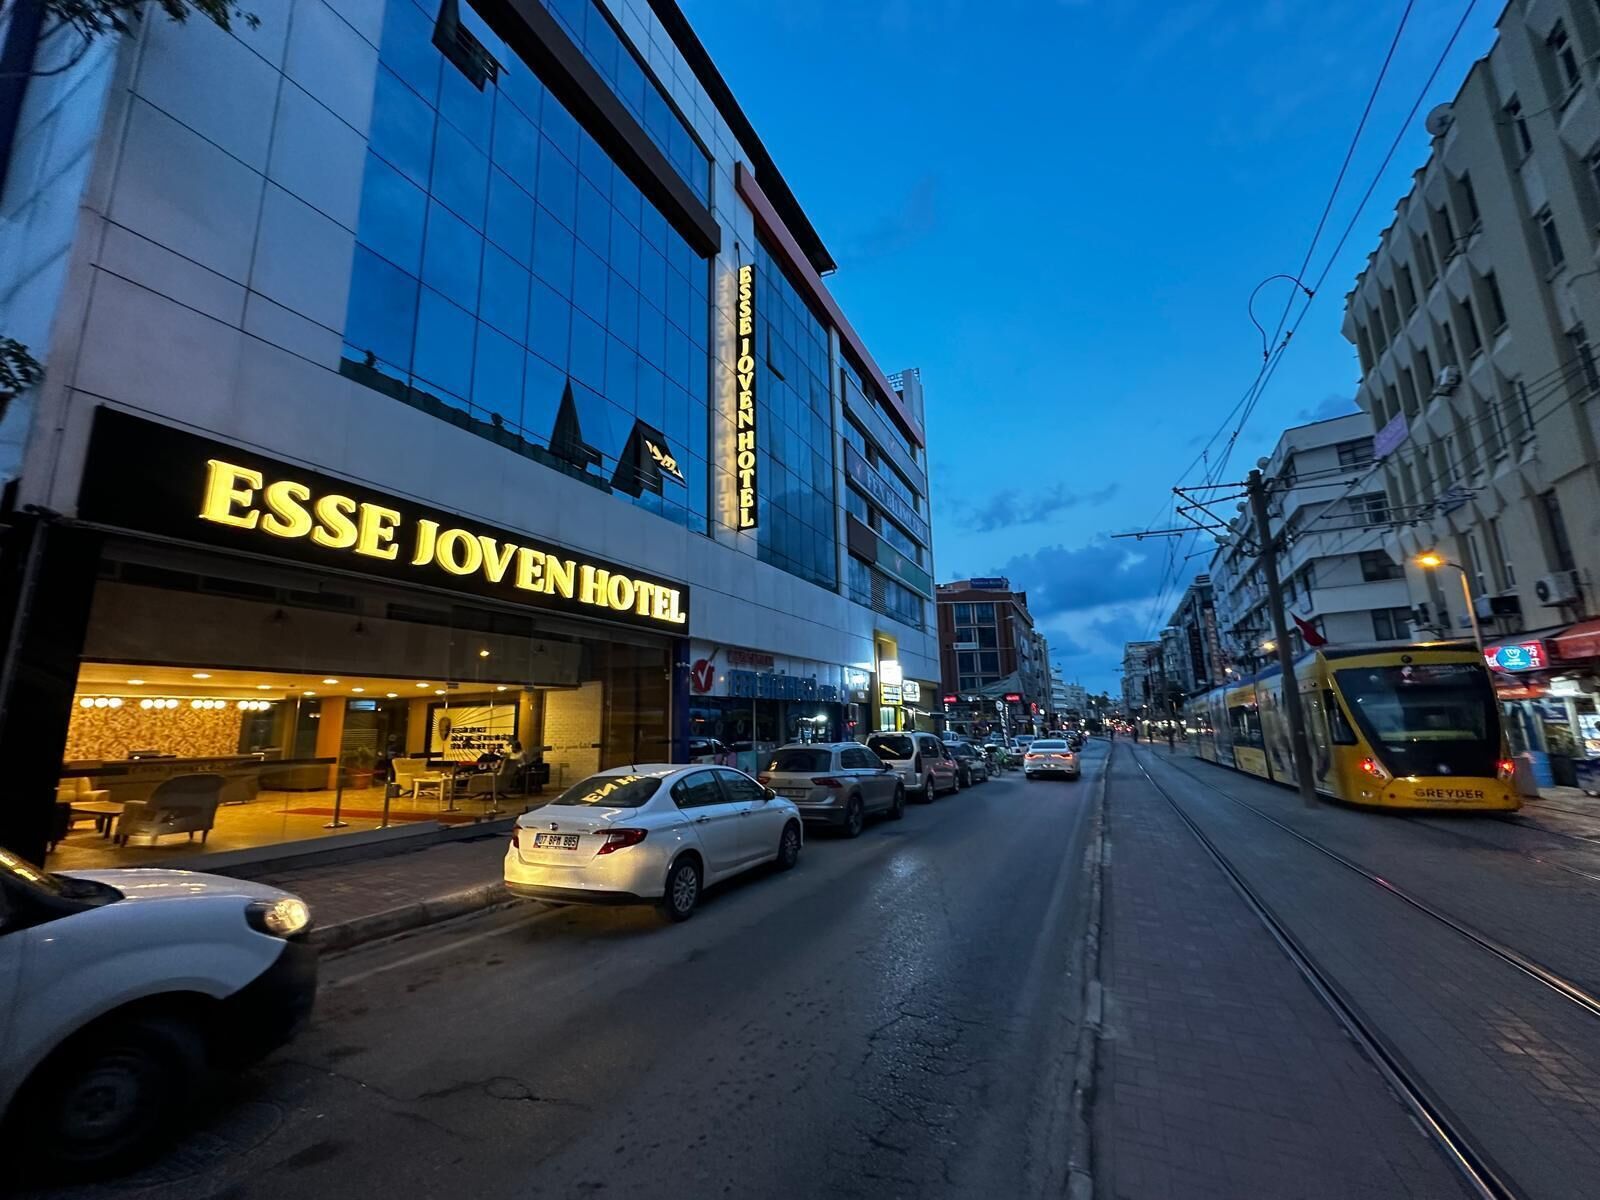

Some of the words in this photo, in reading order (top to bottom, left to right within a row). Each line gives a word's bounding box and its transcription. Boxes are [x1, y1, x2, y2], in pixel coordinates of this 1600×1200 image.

[739, 265, 752, 335] ESSE
[737, 337, 755, 429] JOVEN
[738, 430, 755, 528] HOTEL
[199, 458, 401, 561] ESSE
[412, 519, 576, 599] JOVEN
[578, 566, 687, 625] HOTEL
[1414, 788, 1484, 799] GREYDER
